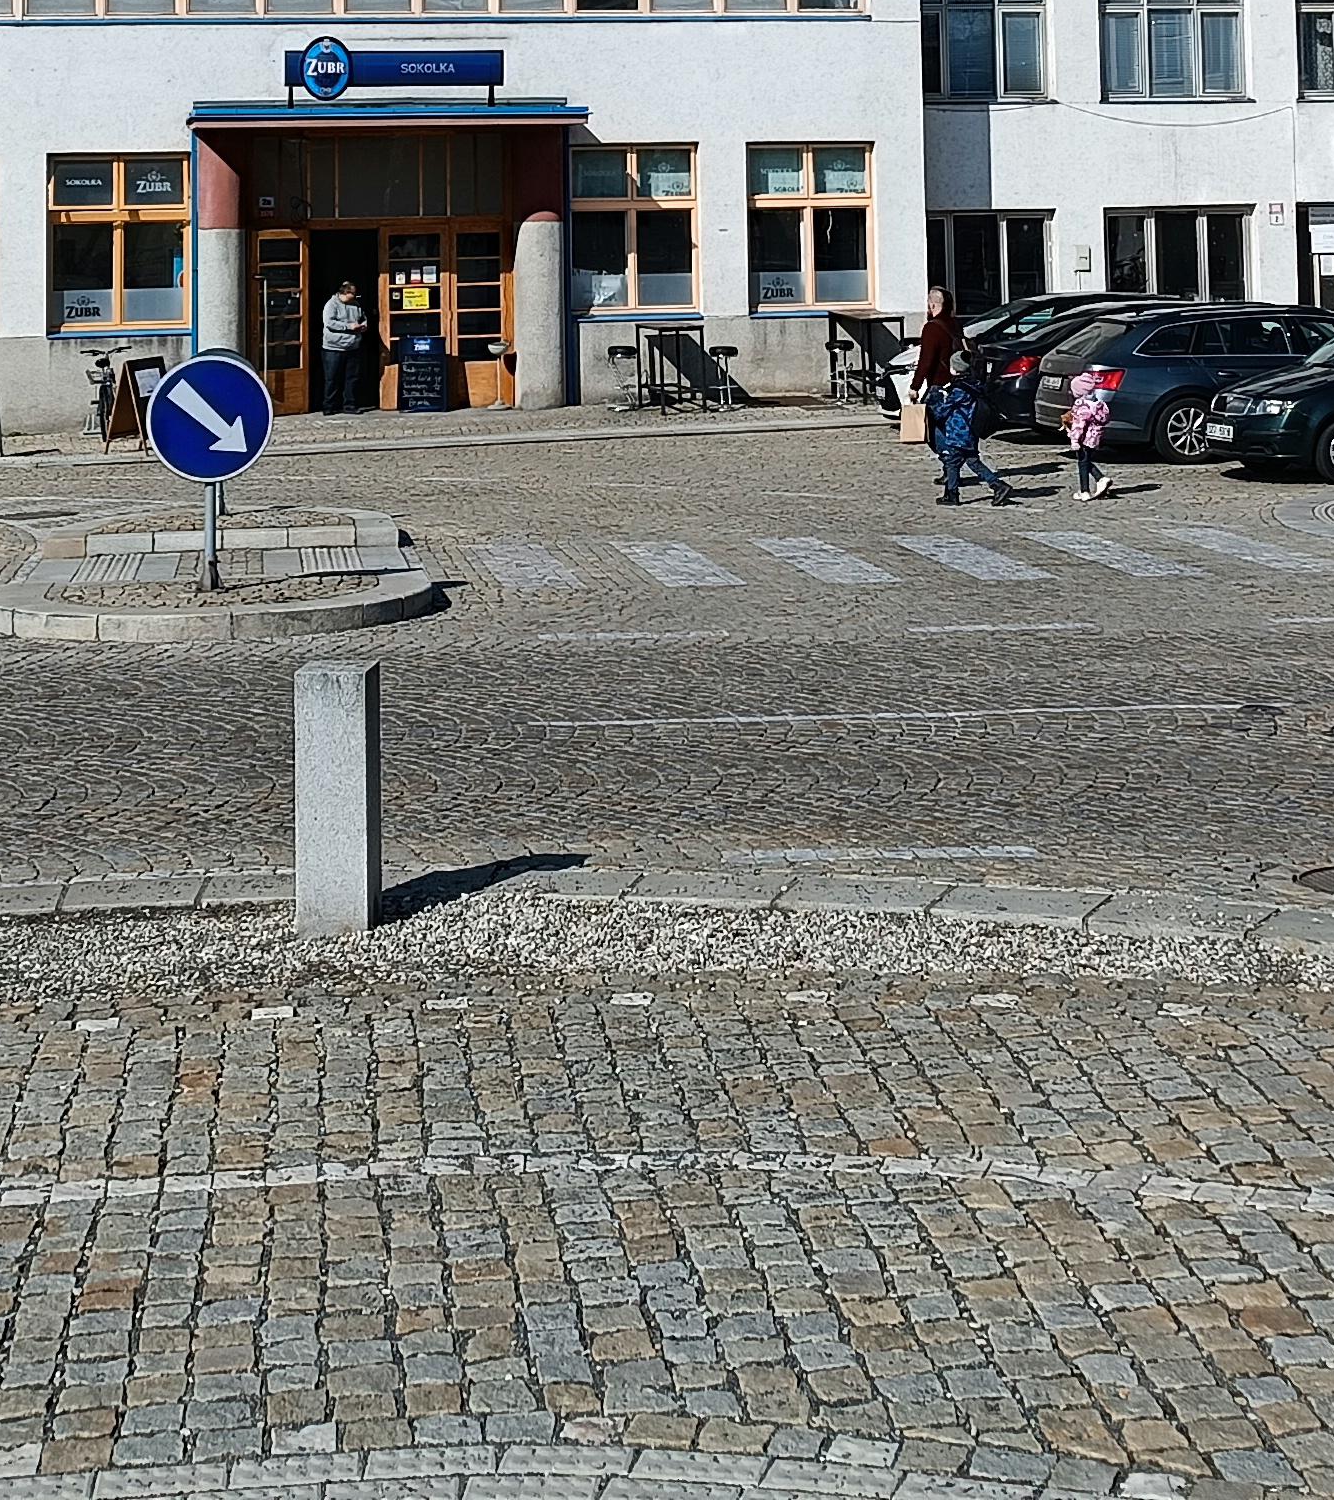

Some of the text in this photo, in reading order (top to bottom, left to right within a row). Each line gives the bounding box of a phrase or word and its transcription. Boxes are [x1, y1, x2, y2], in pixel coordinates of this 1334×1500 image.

[306, 58, 345, 76] ZUBR
[400, 62, 455, 74] SOKOLKA
[65, 178, 103, 186] SOKOLKA
[136, 180, 172, 193] ZUBR
[762, 287, 794, 300] ZUBR
[65, 305, 101, 319] ZUBR
